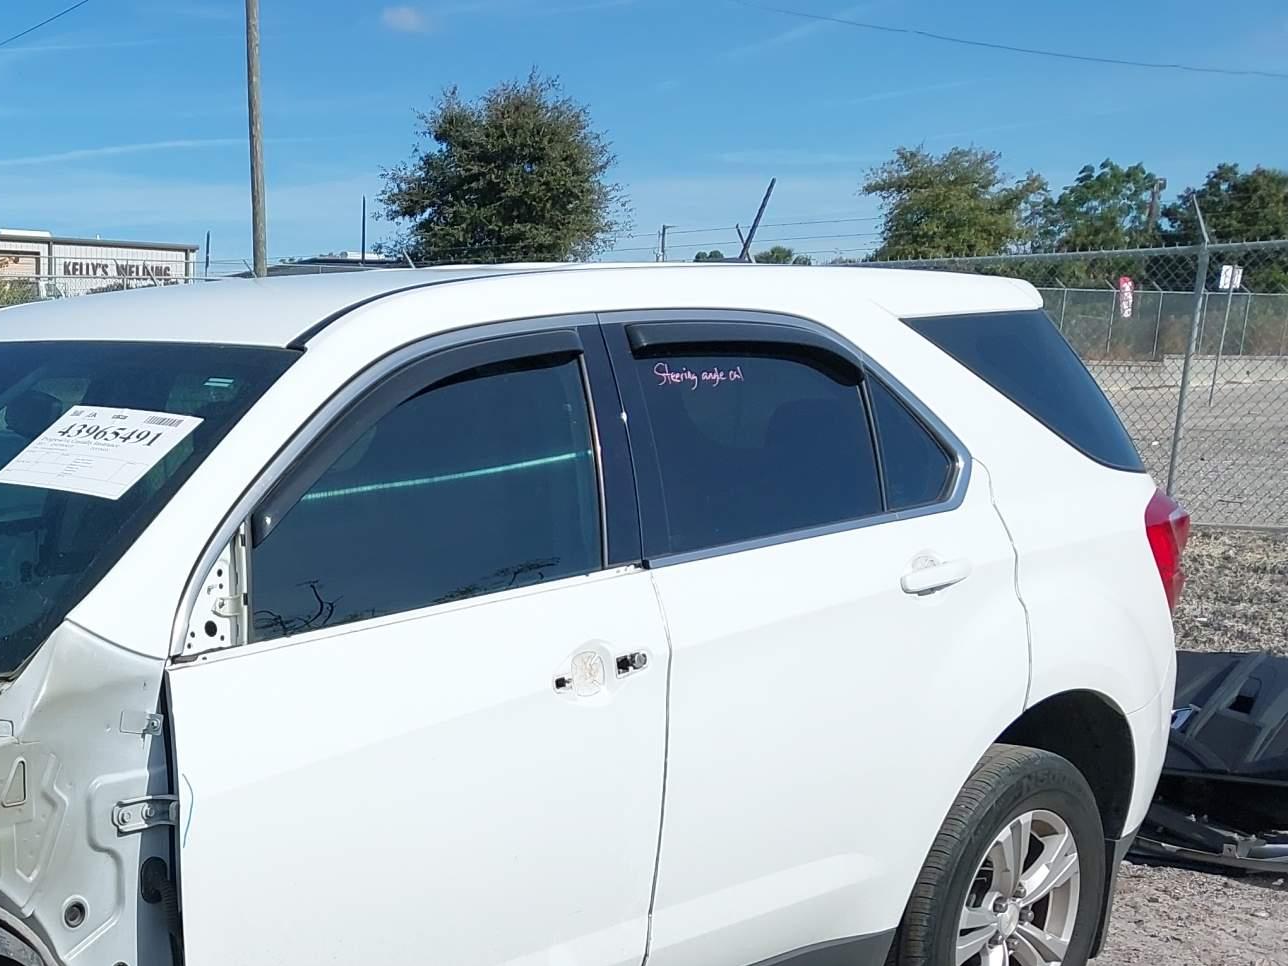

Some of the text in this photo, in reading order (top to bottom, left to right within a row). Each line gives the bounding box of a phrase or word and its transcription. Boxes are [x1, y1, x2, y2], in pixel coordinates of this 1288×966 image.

[63, 260, 109, 277] KELLY'S
[653, 362, 698, 391] Steering
[701, 367, 727, 388] angle
[57, 422, 163, 447] 43965491
